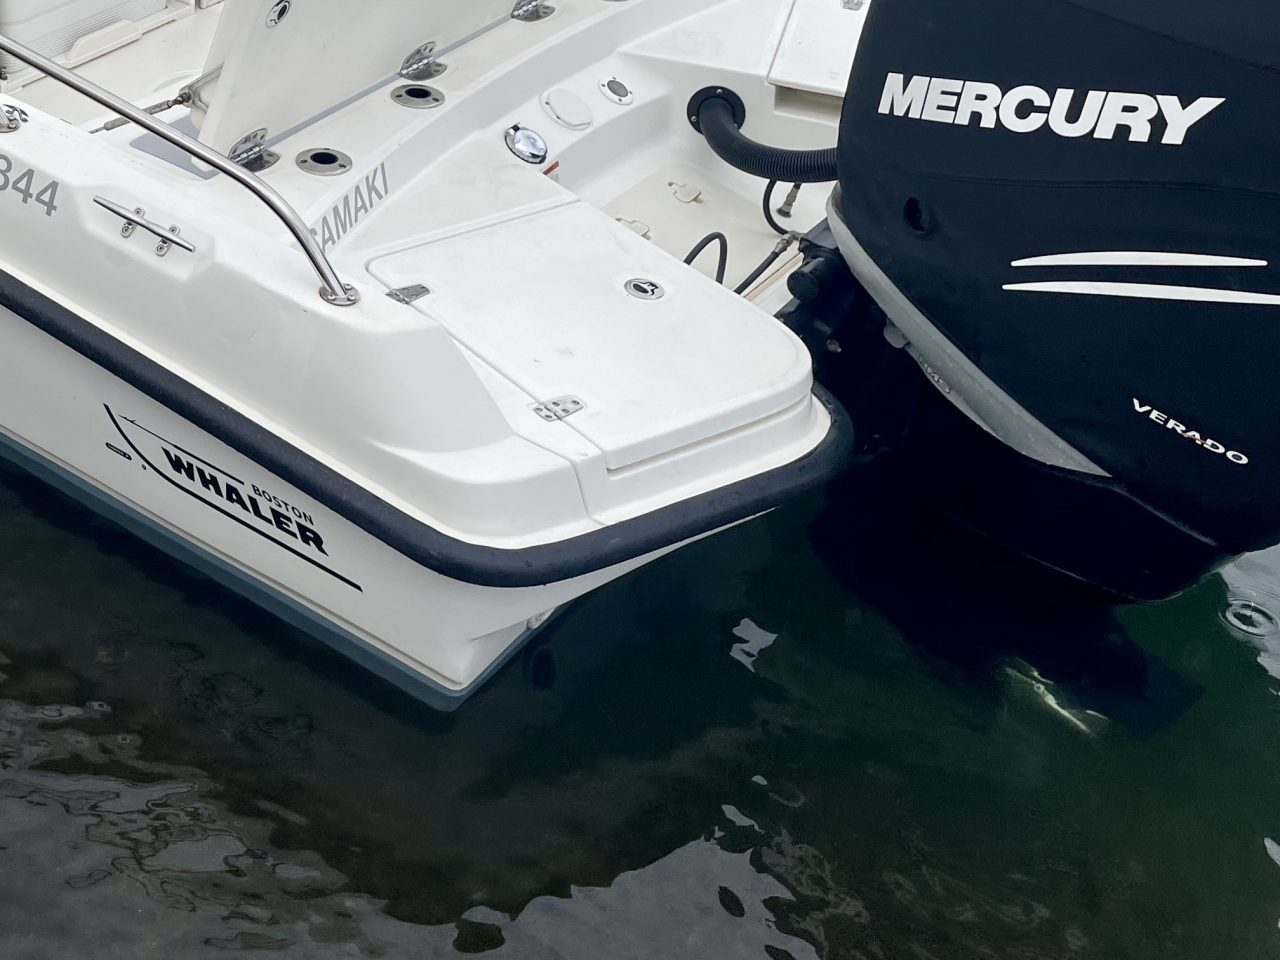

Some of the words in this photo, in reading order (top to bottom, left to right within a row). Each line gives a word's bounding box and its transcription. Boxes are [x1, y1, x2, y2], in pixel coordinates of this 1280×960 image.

[877, 71, 1227, 146] MERCURY
[309, 160, 389, 257] AMAKI
[1131, 397, 1250, 465] VERADO
[160, 445, 330, 557] WHALER
[251, 483, 315, 527] BOSTON
